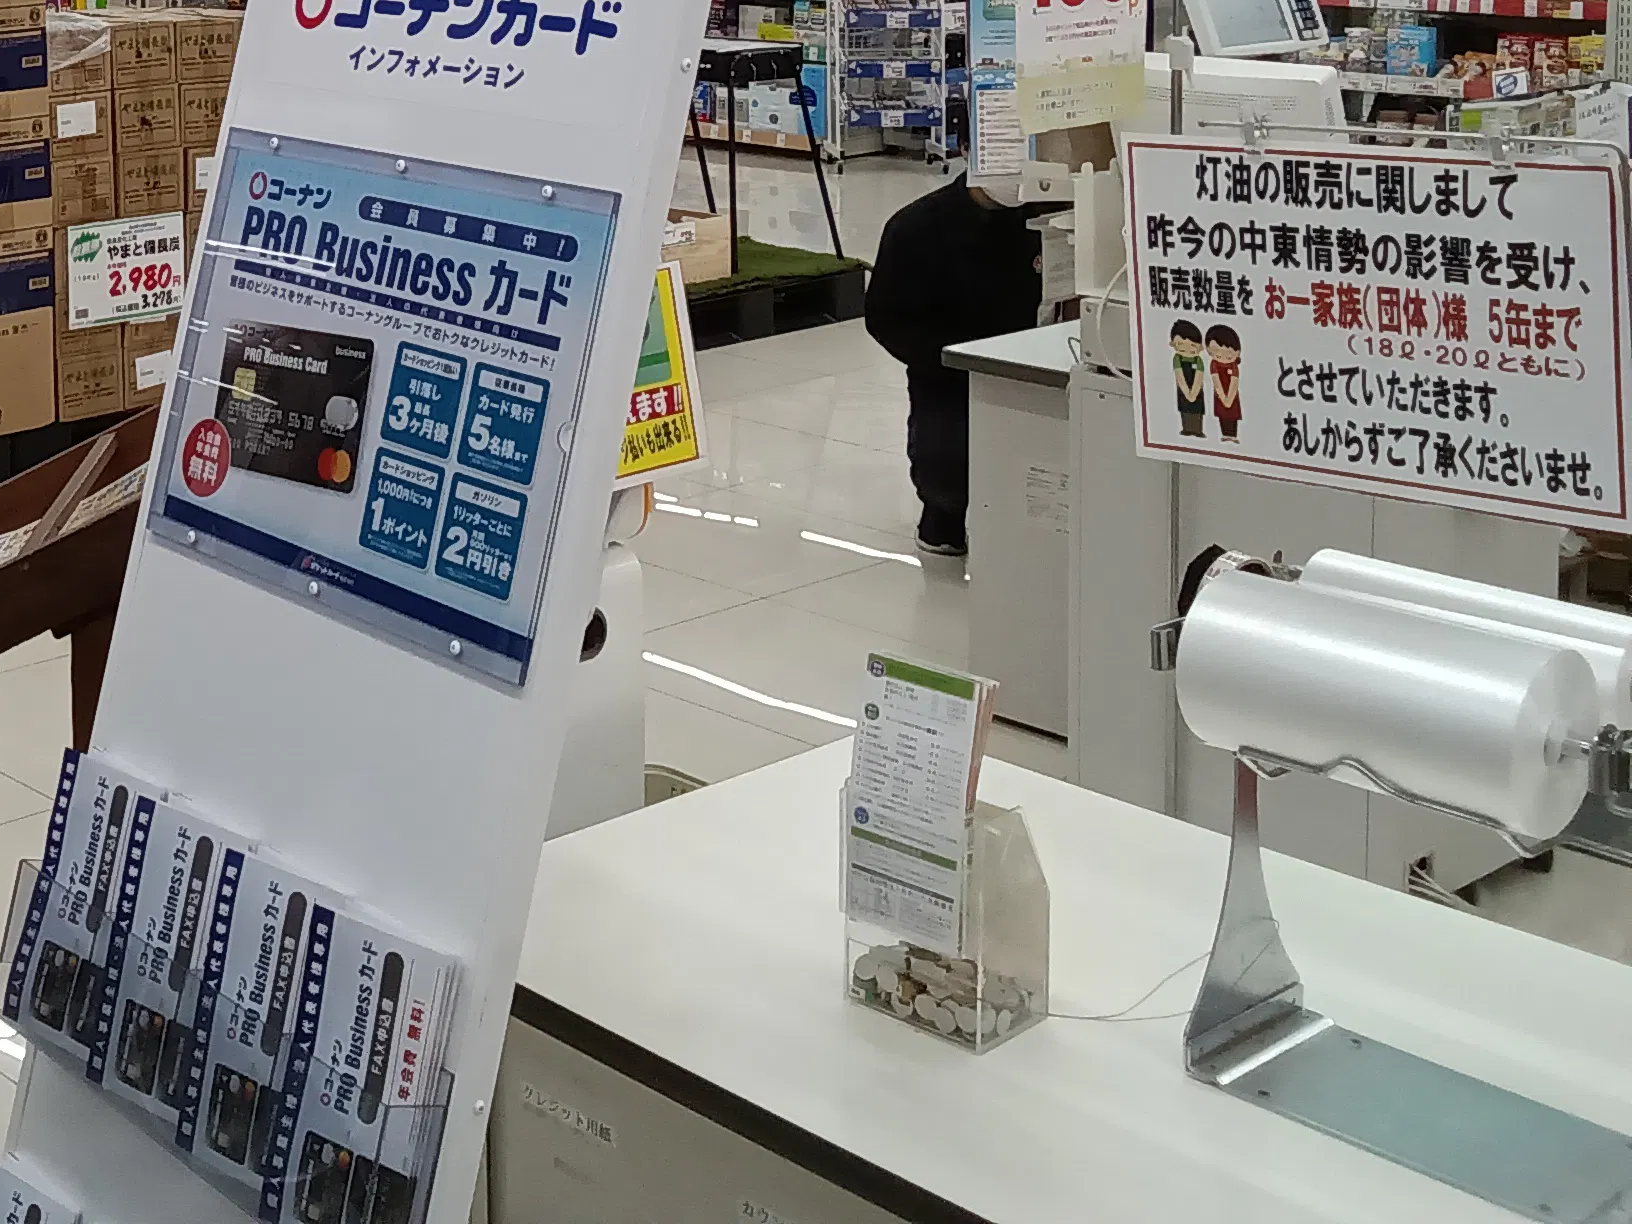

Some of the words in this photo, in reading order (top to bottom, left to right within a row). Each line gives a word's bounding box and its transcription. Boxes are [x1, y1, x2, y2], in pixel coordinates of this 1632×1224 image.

[348, 45, 526, 90] インフォメーション
[267, 178, 332, 209] コーナン
[1196, 153, 1519, 219] 灯油の販売に関しまして
[107, 236, 180, 261] やまと備長炭
[239, 205, 308, 265] PRO
[313, 221, 477, 307] Business
[482, 259, 573, 325] カード
[1146, 214, 1592, 294] 昨今の中東情勢の影響を受け、
[109, 262, 173, 297] 2,980
[1488, 297, 1583, 353] 5缶まで
[305, 357, 329, 375] Card
[478, 394, 535, 425] カード発行
[1276, 355, 1511, 428] とさせていただきます。
[1282, 411, 1604, 501] あしからずご了承くださいませ。
[176, 825, 193, 862] カード
[157, 866, 186, 947] Business
[264, 879, 284, 921] カード
[149, 946, 169, 984] PRO
[248, 925, 280, 1009] Business
[356, 939, 378, 982] カード
[239, 1007, 262, 1048] PRO
[343, 985, 372, 1076] Business
[333, 1073, 359, 1116] PRO
